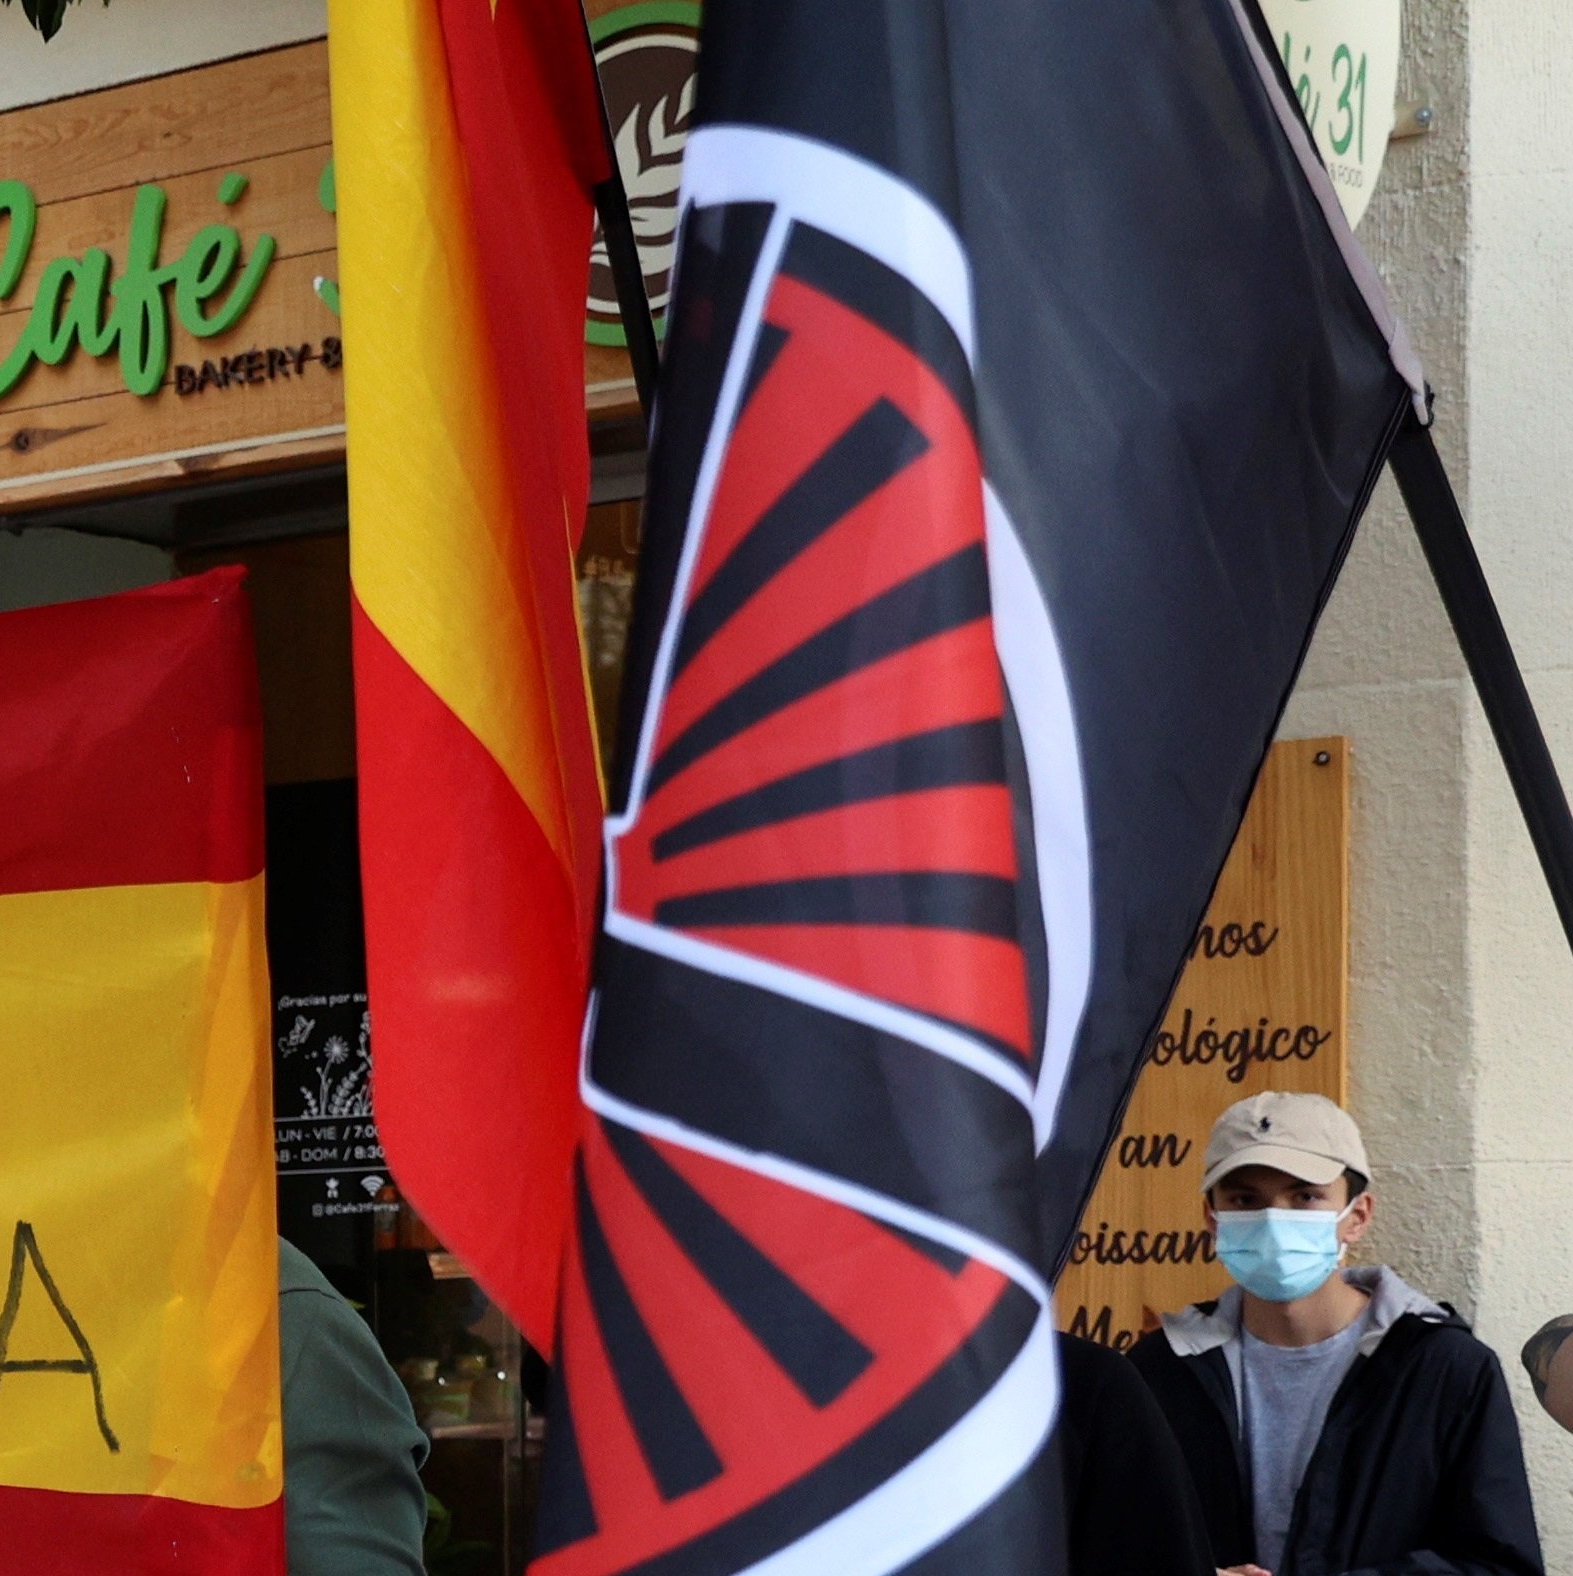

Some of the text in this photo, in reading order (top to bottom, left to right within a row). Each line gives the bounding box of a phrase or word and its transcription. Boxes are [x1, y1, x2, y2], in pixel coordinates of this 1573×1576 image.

[1328, 43, 1366, 165] 31
[174, 342, 310, 396] BAKERY
[1142, 1008, 1332, 1083] ológico
[300, 1147, 338, 1162] DOM
[313, 1126, 337, 1140] VIE
[1118, 1132, 1192, 1168] an
[1069, 1222, 1217, 1265] oissan
